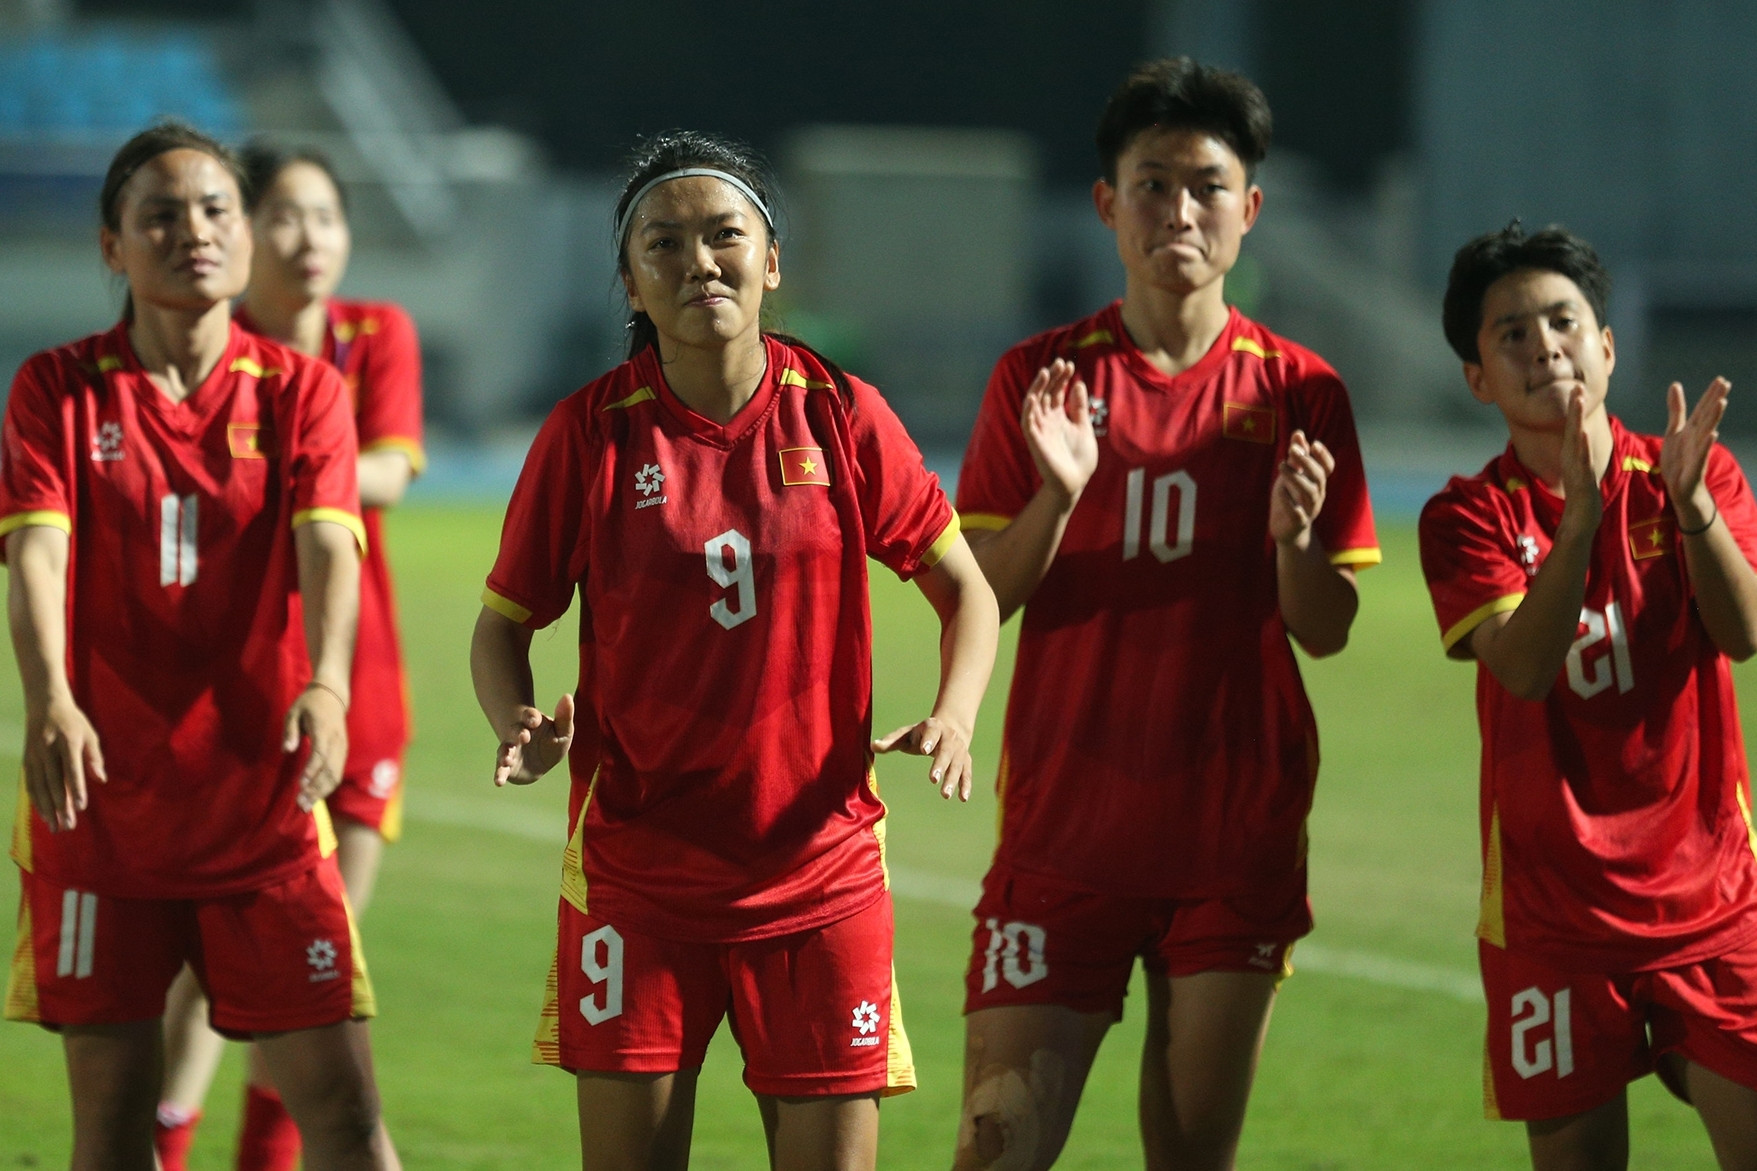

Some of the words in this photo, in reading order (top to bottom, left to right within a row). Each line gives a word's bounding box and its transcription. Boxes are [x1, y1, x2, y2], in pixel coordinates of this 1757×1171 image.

[160, 493, 198, 588] 11
[1123, 466, 1198, 563] 10
[704, 528, 757, 631] 9
[1565, 601, 1635, 700] 21
[57, 888, 98, 979] 11
[579, 924, 624, 1026] 9
[982, 918, 1048, 994] 10
[1511, 985, 1574, 1080] 21
